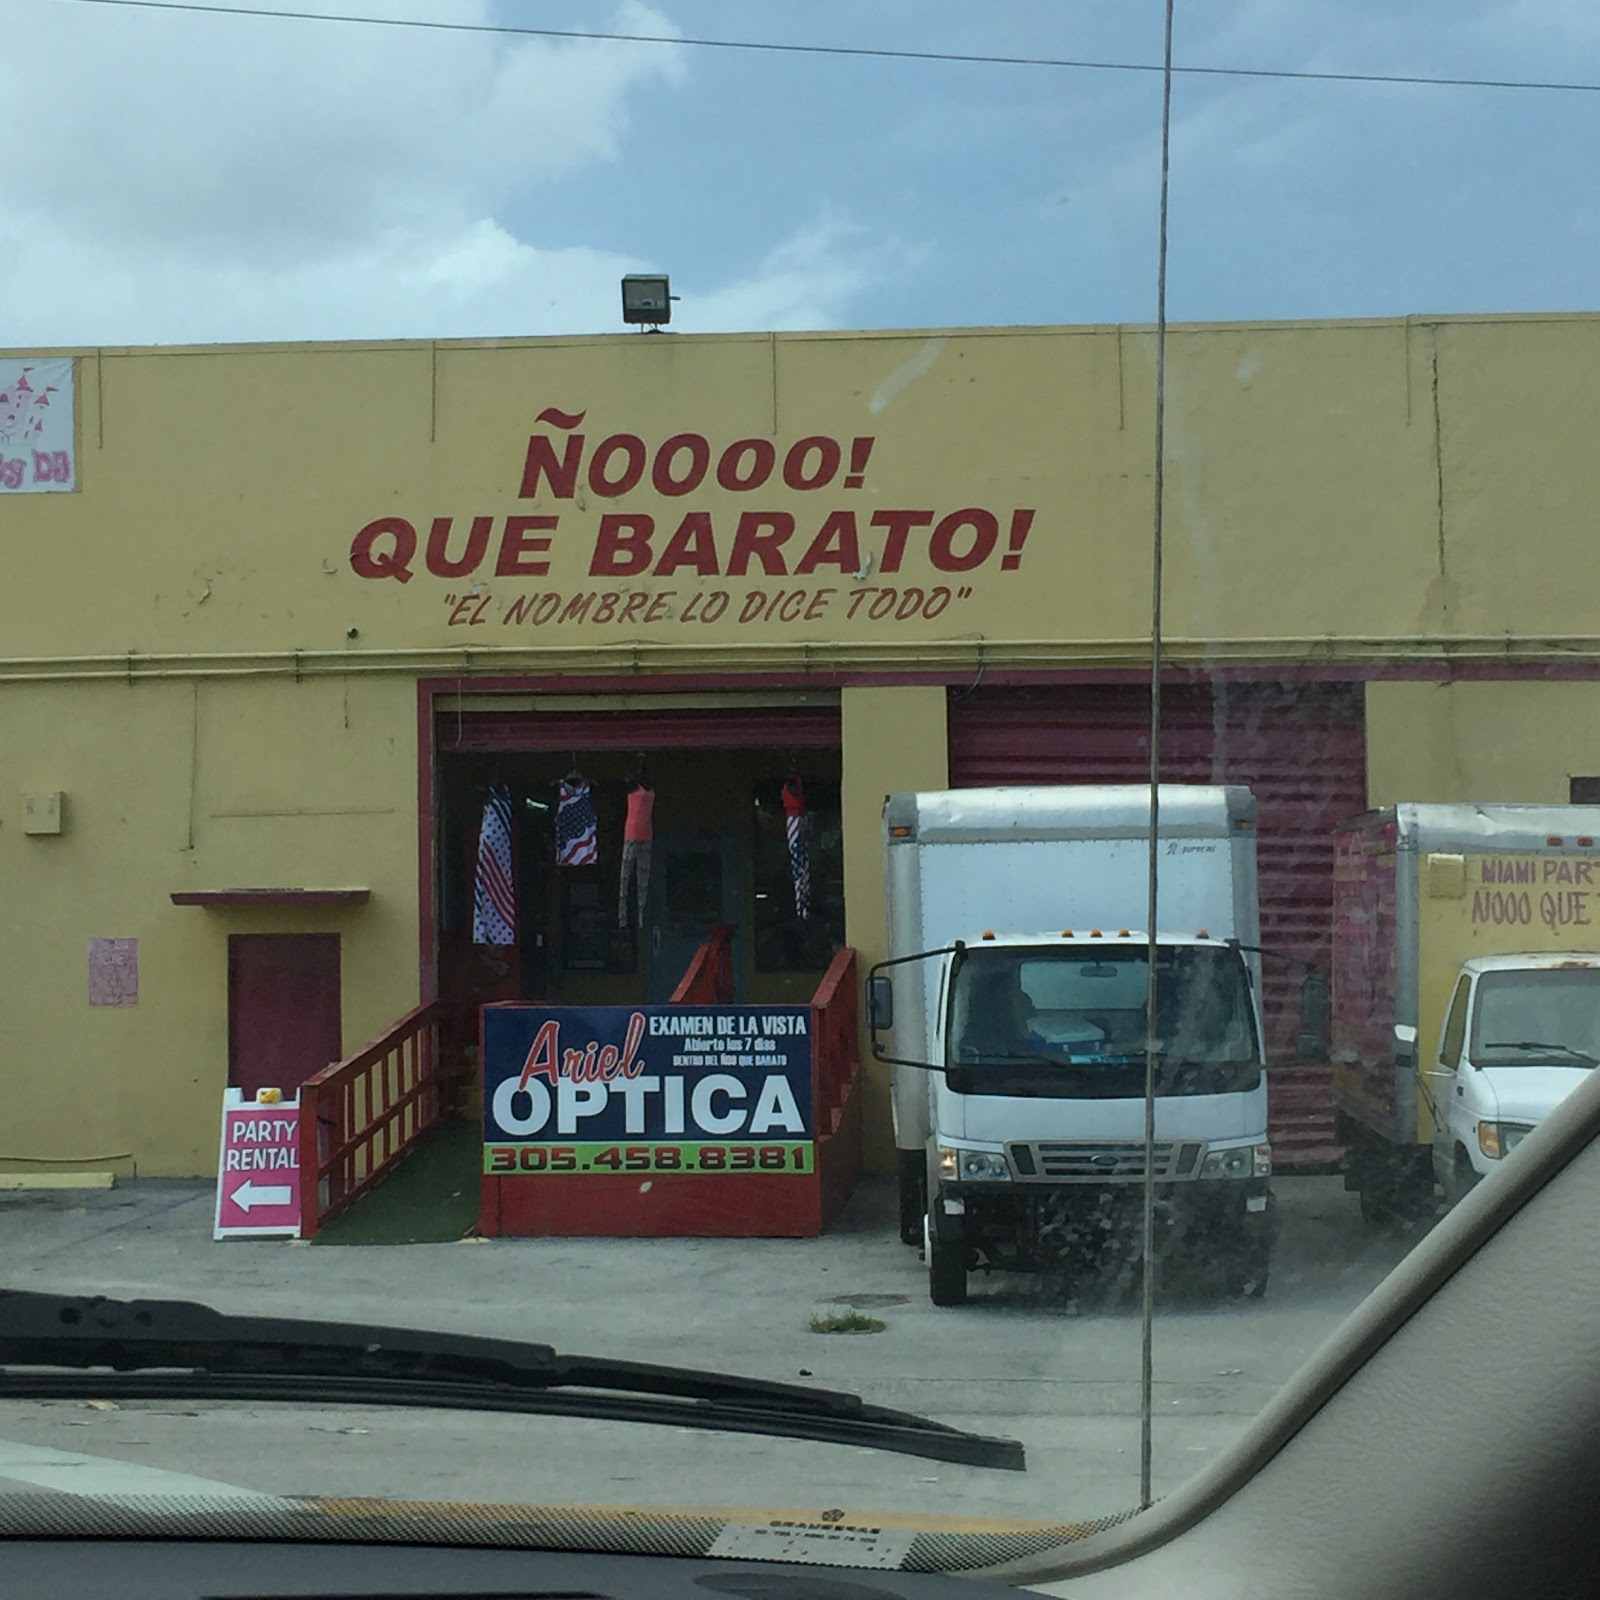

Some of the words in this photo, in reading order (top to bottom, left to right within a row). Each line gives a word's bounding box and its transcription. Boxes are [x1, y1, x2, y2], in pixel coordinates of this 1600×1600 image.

[518, 407, 875, 499] ÑOOOO!
[350, 516, 560, 584] QUE
[588, 508, 1036, 577] BARATO!
[444, 594, 492, 626] "EL
[502, 591, 677, 626] NOMBRE
[679, 591, 730, 625] LO
[738, 588, 838, 624] DICE
[845, 586, 973, 622] TODO"
[1481, 859, 1536, 884] MIAMI
[1540, 891, 1591, 936] QUE
[649, 1016, 713, 1036] EXAMEN
[717, 1016, 736, 1035] DE
[739, 1016, 759, 1035] LA
[762, 1015, 807, 1035] VISTA
[519, 1012, 646, 1091] Ariel
[683, 1037, 725, 1052] Abierto
[726, 1038, 743, 1051] los
[744, 1038, 752, 1051] 7
[672, 1055, 704, 1067] DENTRO
[704, 1055, 719, 1066] DEL
[738, 1055, 754, 1067] QUE
[492, 1074, 806, 1137] OPTICA
[232, 1120, 298, 1144] PARTY
[226, 1147, 301, 1172] RENTAL
[491, 1146, 806, 1172] 305.458.8381
